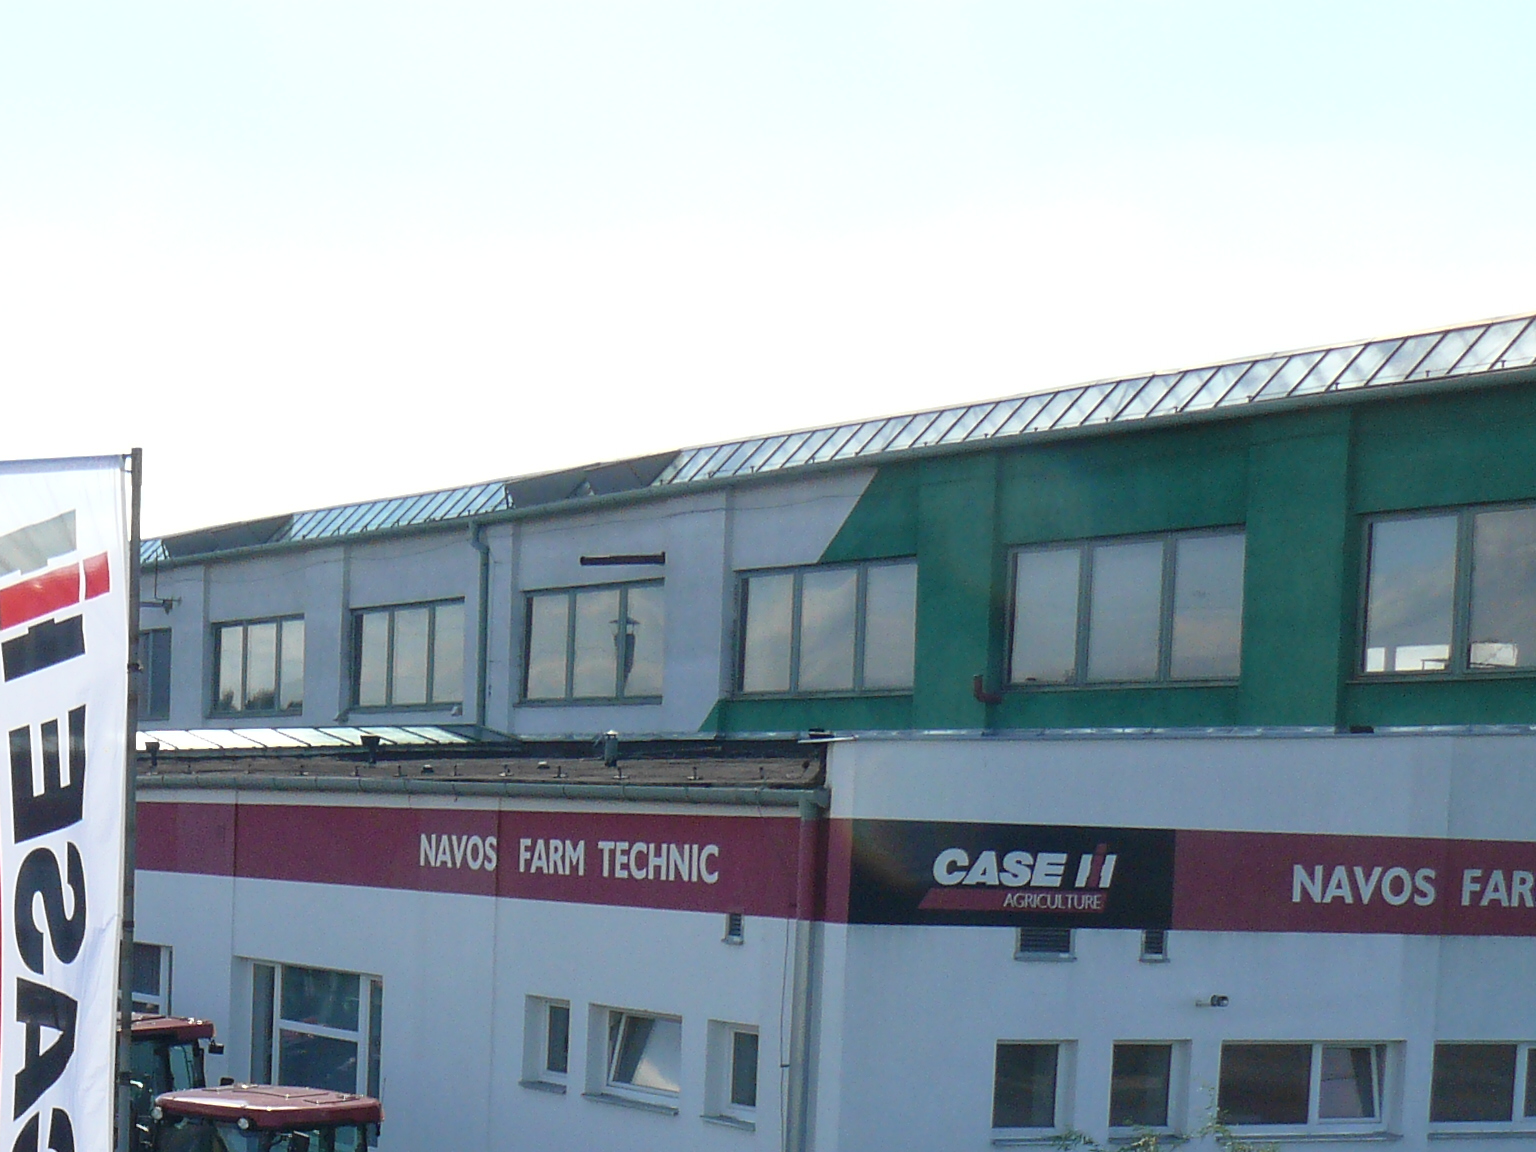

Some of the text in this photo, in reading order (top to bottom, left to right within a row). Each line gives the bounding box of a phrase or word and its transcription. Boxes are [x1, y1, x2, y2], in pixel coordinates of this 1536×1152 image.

[419, 832, 720, 885] NAVOS FARM TECHNIC
[932, 847, 1068, 888] CASE
[1002, 892, 1103, 911] AGRICULTURE
[1291, 863, 1536, 908] NAVOS FAR
